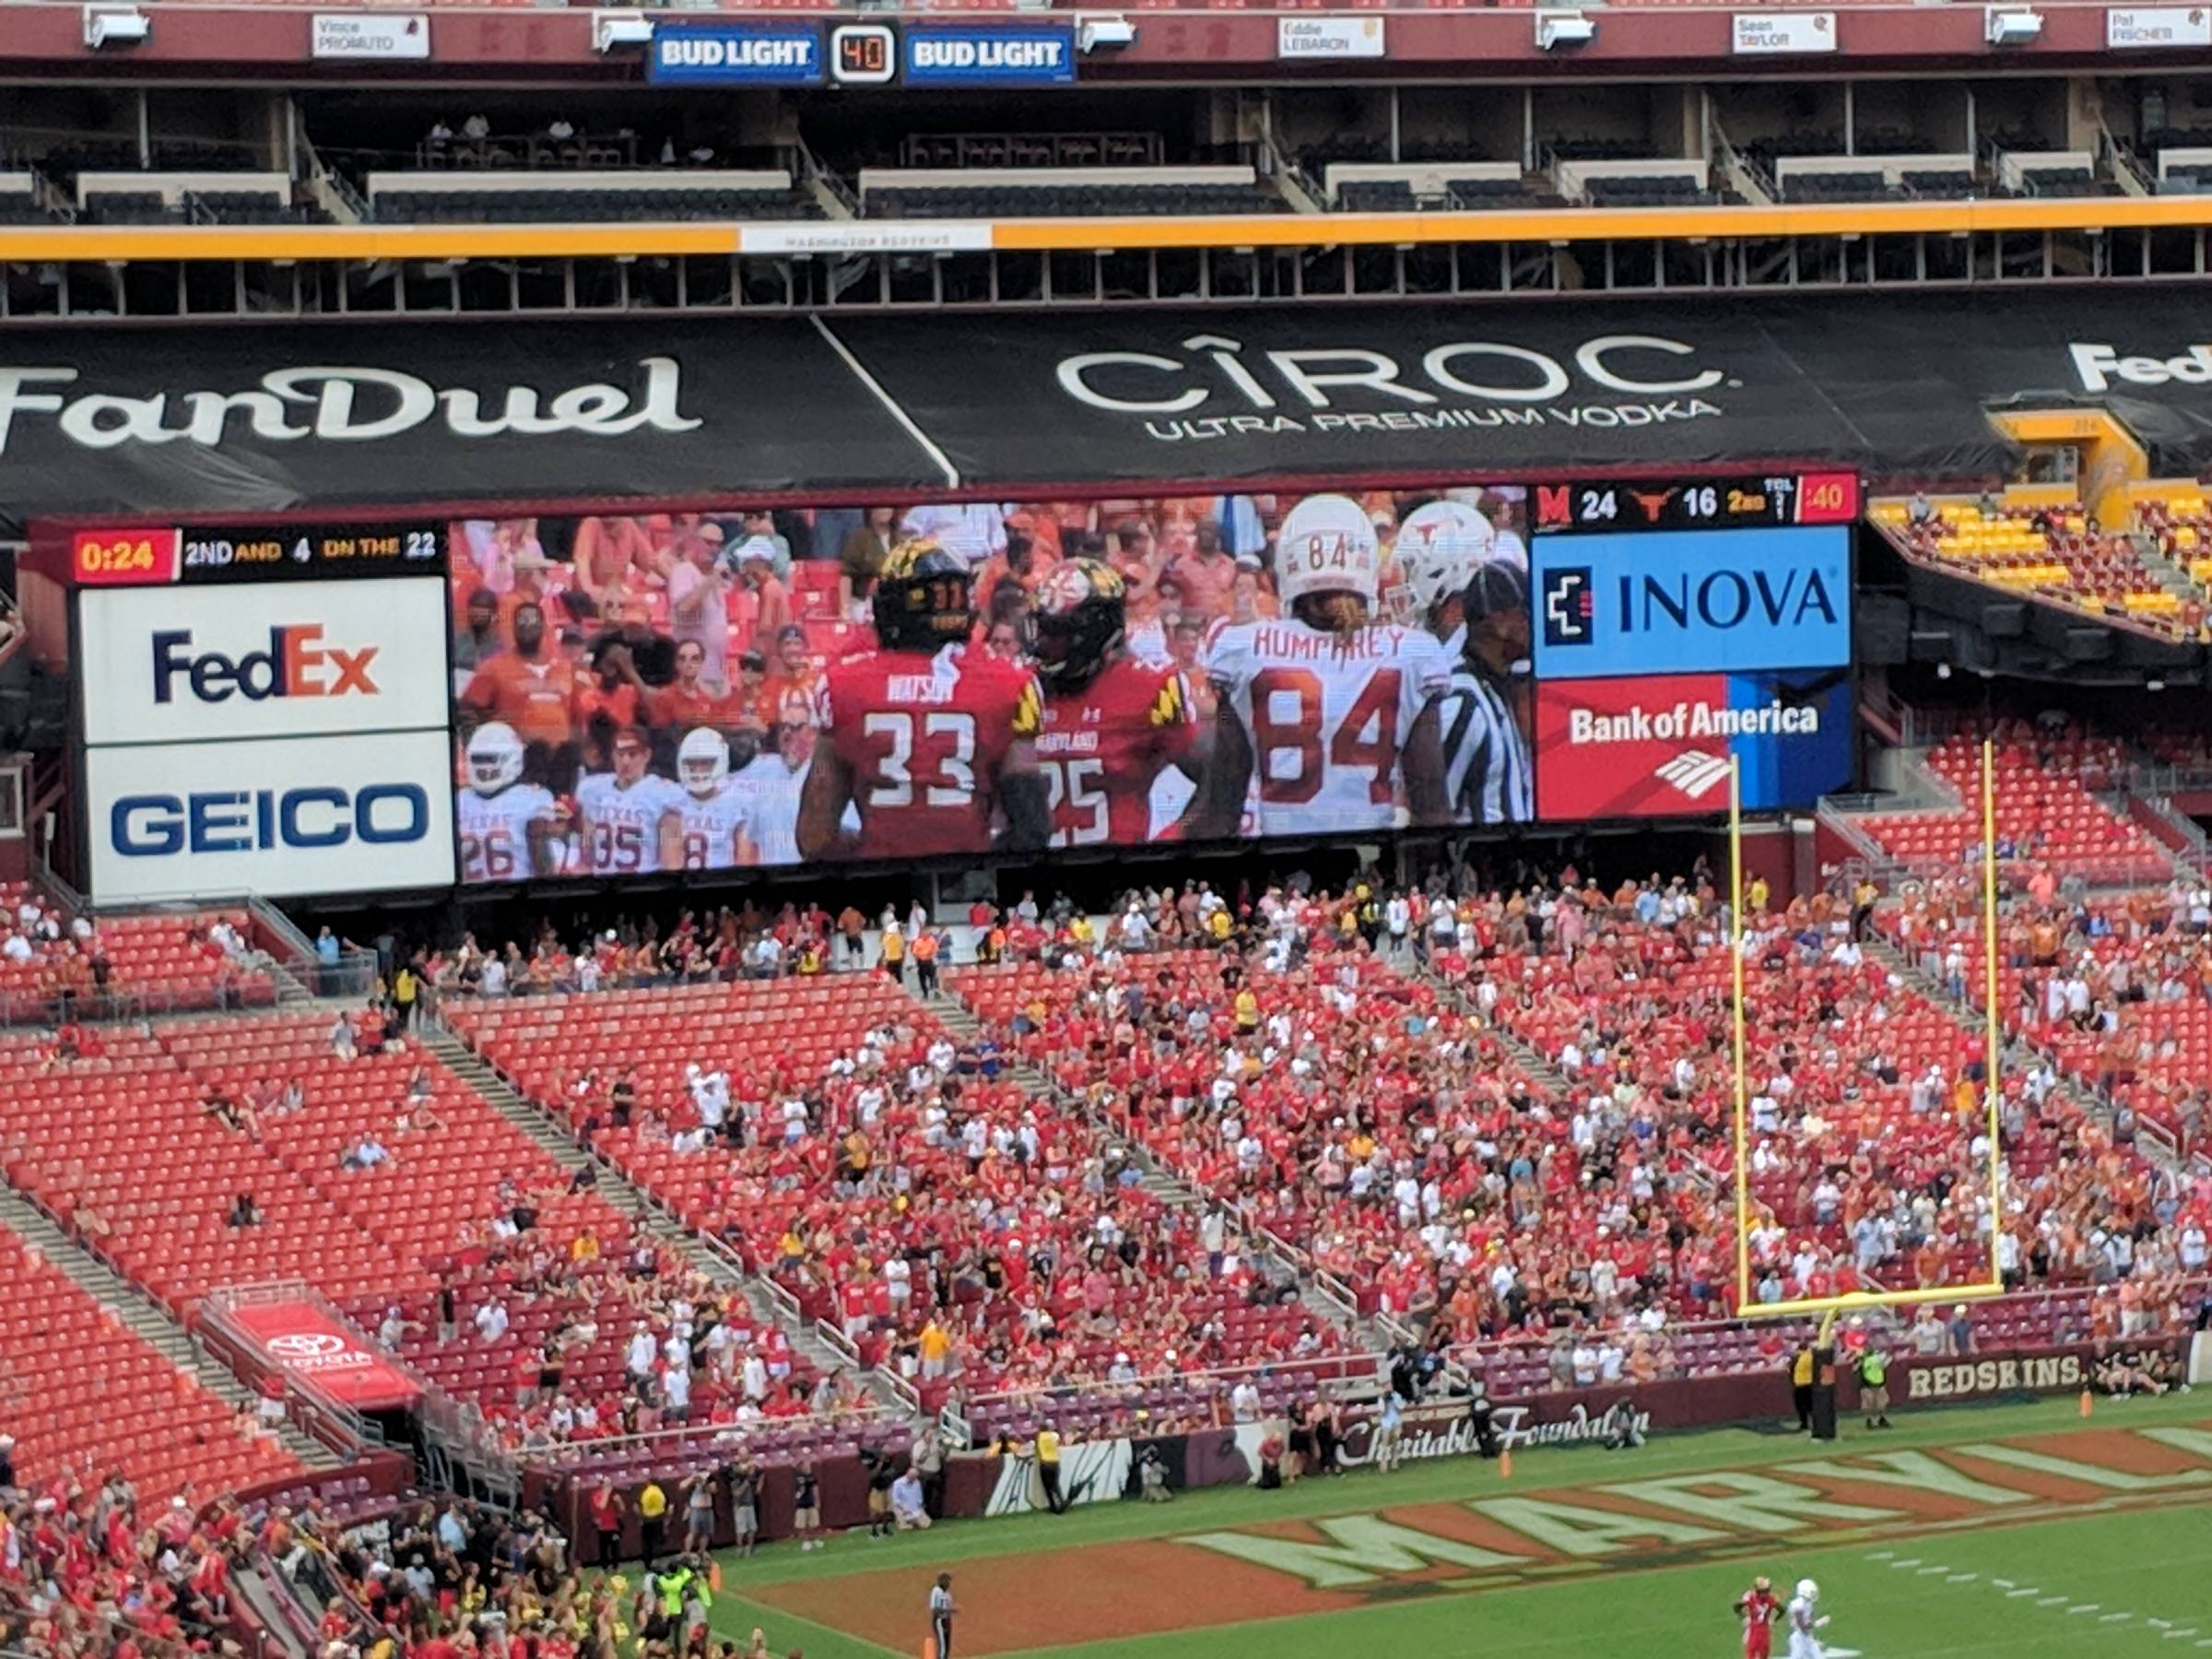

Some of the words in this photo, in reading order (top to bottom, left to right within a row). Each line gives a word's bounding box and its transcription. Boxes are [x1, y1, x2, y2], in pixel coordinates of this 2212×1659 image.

[661, 40, 724, 67] BUD
[726, 40, 811, 66] LIGHT
[842, 37, 883, 70] 40
[913, 41, 975, 67] BUD
[978, 41, 1062, 67] LIGHT
[0, 358, 703, 453] FanDuel
[1145, 411, 1306, 441] ULTRA
[1312, 406, 1544, 434] PREMIUM
[1549, 397, 1723, 428] VODKA
[1581, 489, 1618, 520] 24
[1683, 487, 1717, 516] 16
[81, 540, 155, 571] 0:24
[185, 540, 233, 566] 2ND
[234, 542, 282, 563] AND
[292, 537, 312, 563] 4
[359, 536, 399, 556] THE
[406, 532, 435, 559] 22
[1308, 532, 1347, 571] 84
[1619, 569, 1837, 632] INOVA
[152, 623, 382, 704] FedEx
[1250, 666, 1402, 805] 84
[1571, 706, 1653, 744] Bank
[1654, 702, 1688, 737] of
[1689, 700, 1818, 738] America
[864, 712, 974, 807] 33
[111, 782, 429, 856] GEICO
[461, 830, 513, 880] 26
[594, 822, 642, 873] 35
[1335, 1418, 1482, 1466] Chritabl
[1490, 1404, 1651, 1451] Foundatn
